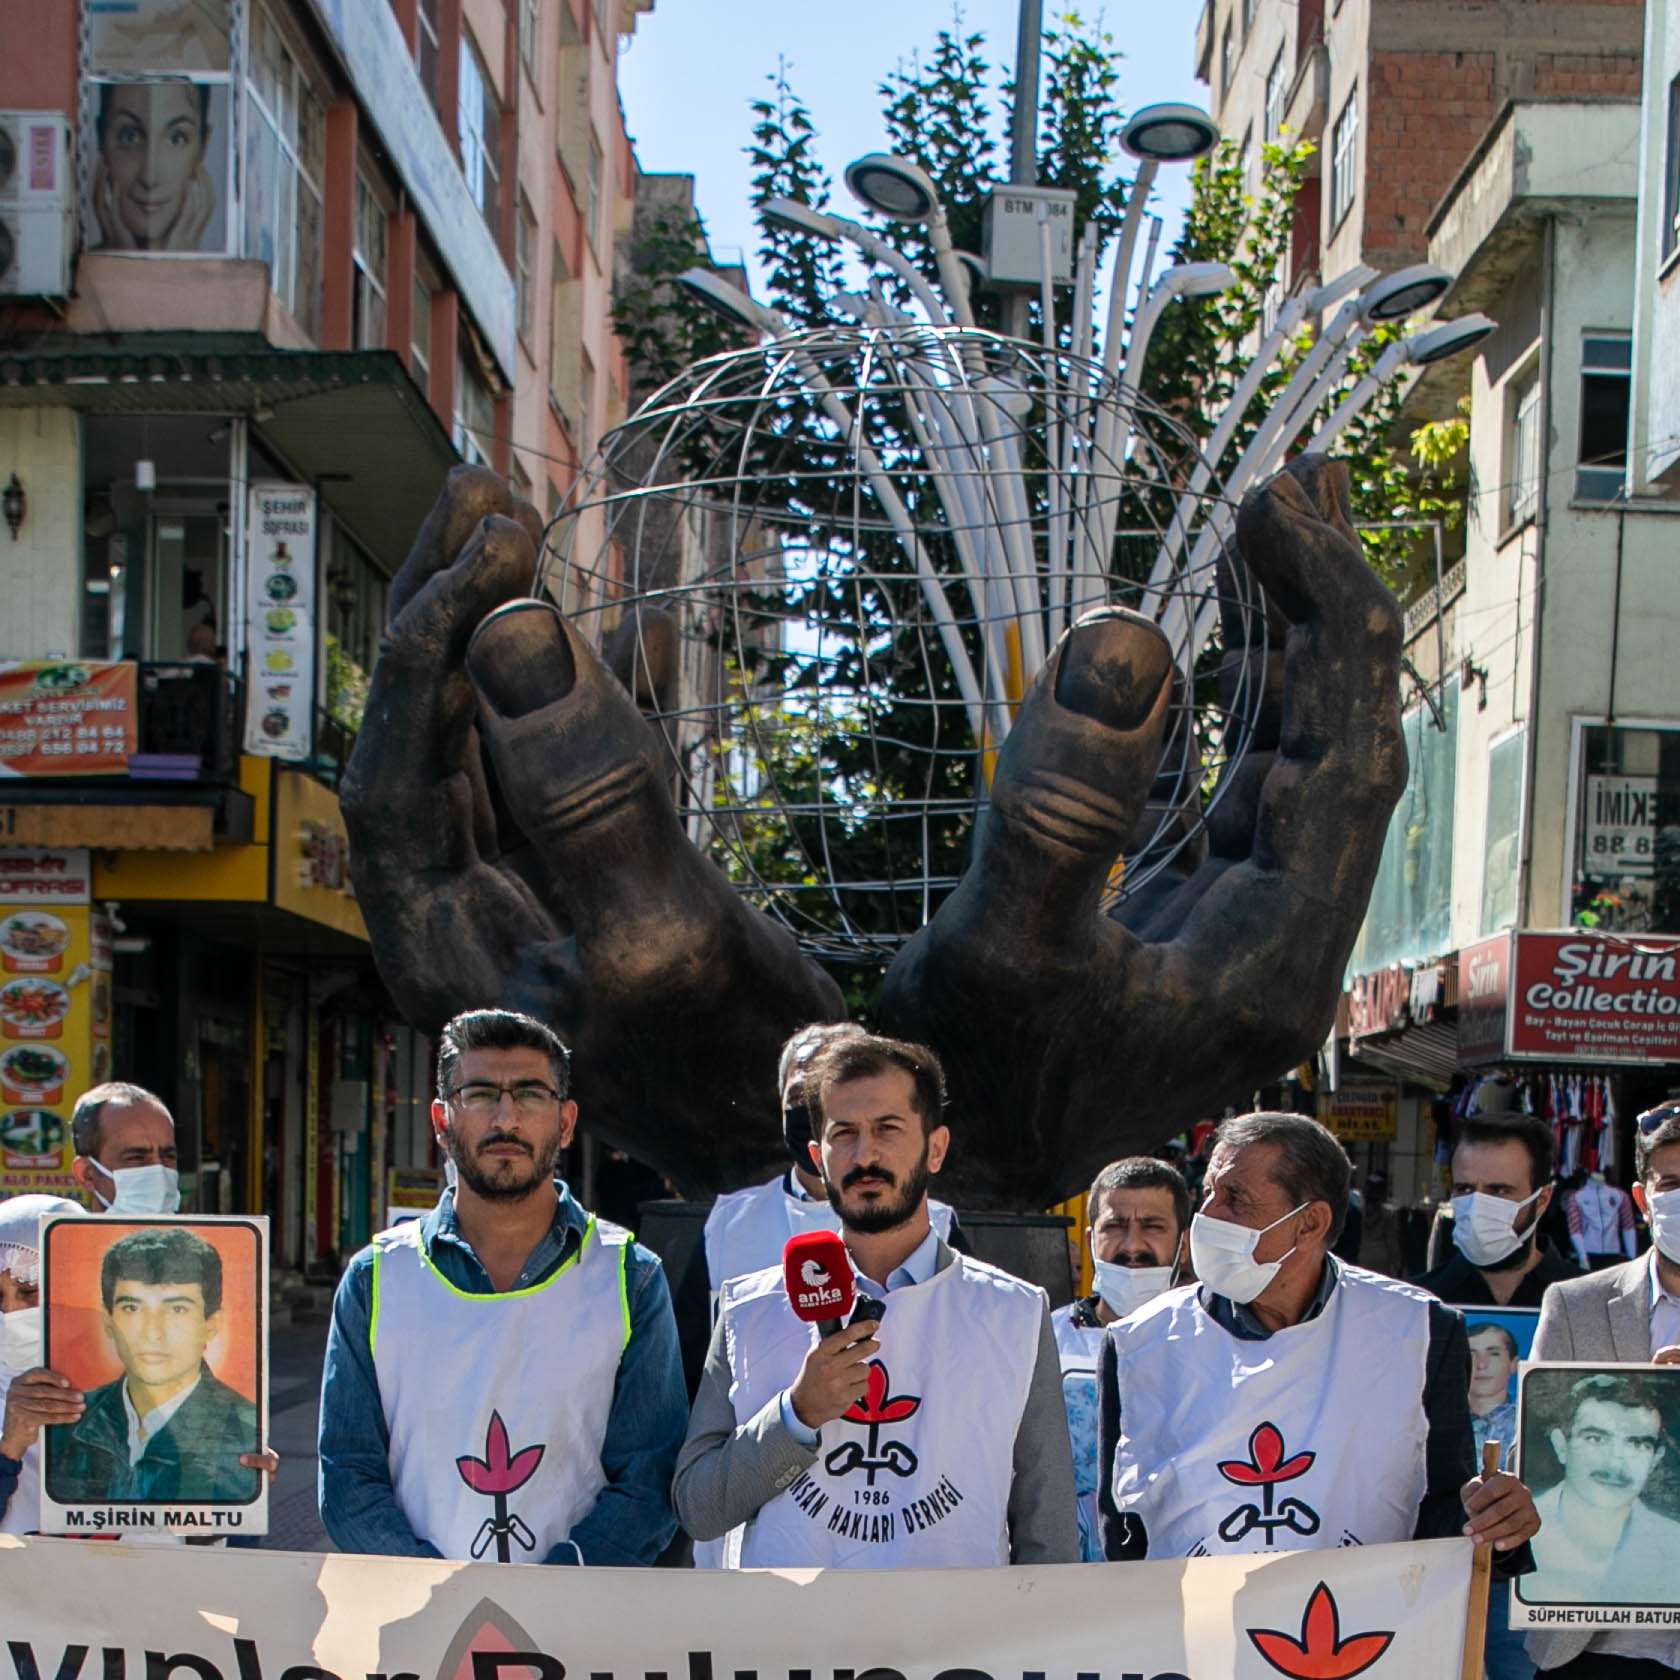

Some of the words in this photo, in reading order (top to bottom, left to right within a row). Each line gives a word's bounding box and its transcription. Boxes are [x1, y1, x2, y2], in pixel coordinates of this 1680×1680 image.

[1004, 200, 1033, 214] BTM
[1553, 943, 1677, 986] Şirin
[1525, 1015, 1545, 1027] Bay
[798, 1286, 842, 1303] anka
[853, 1489, 890, 1506] 1986
[828, 1504, 896, 1543] HAKLARI
[902, 1473, 965, 1534] DERNEĞİ
[65, 1505, 158, 1533] M.ŞİRİN
[164, 1509, 242, 1528] MALTU
[1527, 1606, 1631, 1624] SÜPHETULLAH
